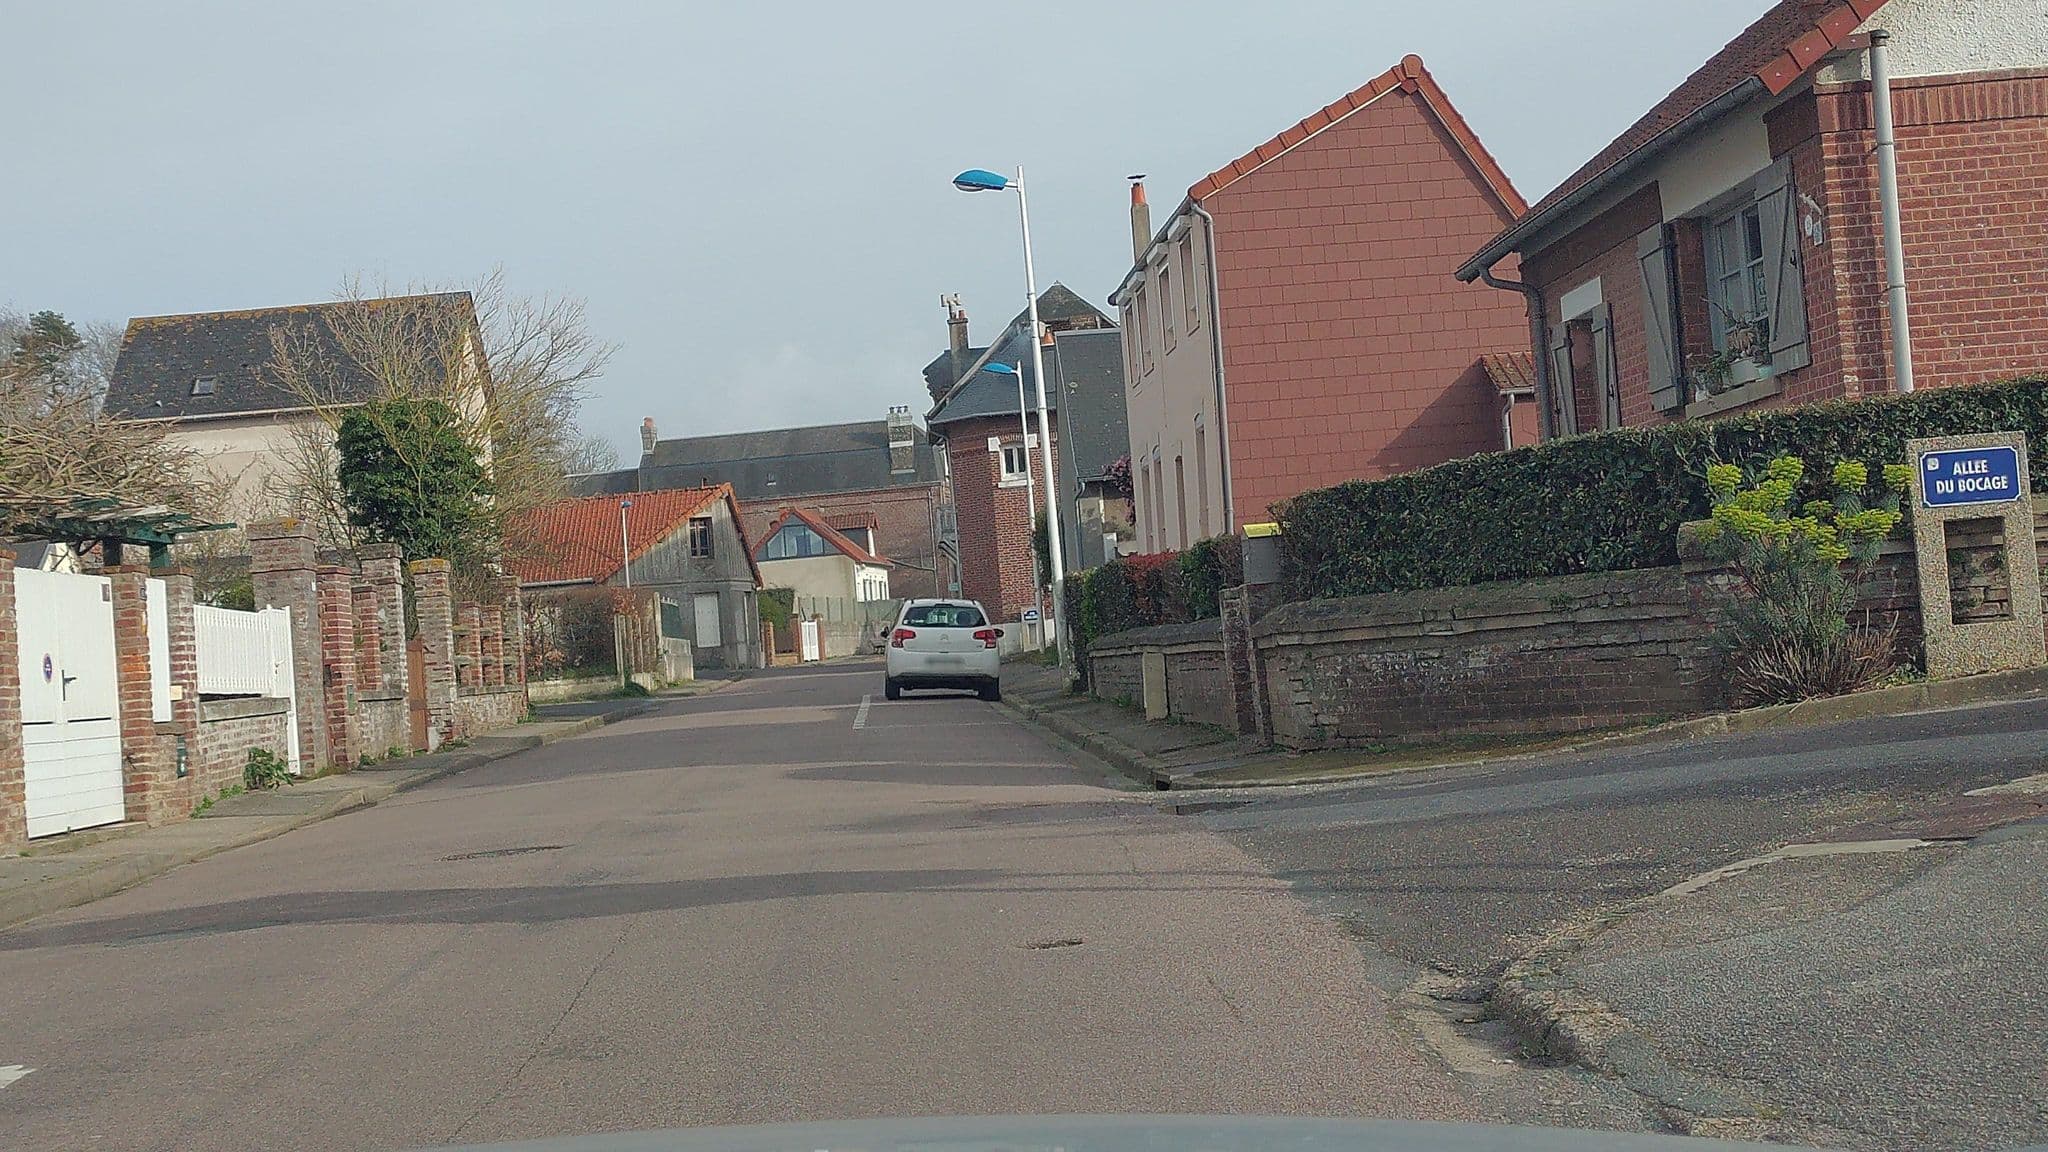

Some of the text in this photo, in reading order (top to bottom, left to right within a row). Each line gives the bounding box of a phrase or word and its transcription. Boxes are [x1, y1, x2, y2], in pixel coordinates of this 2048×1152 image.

[1953, 460, 1988, 475] ALLEE
[1936, 476, 2008, 494] DU BOCAGE
